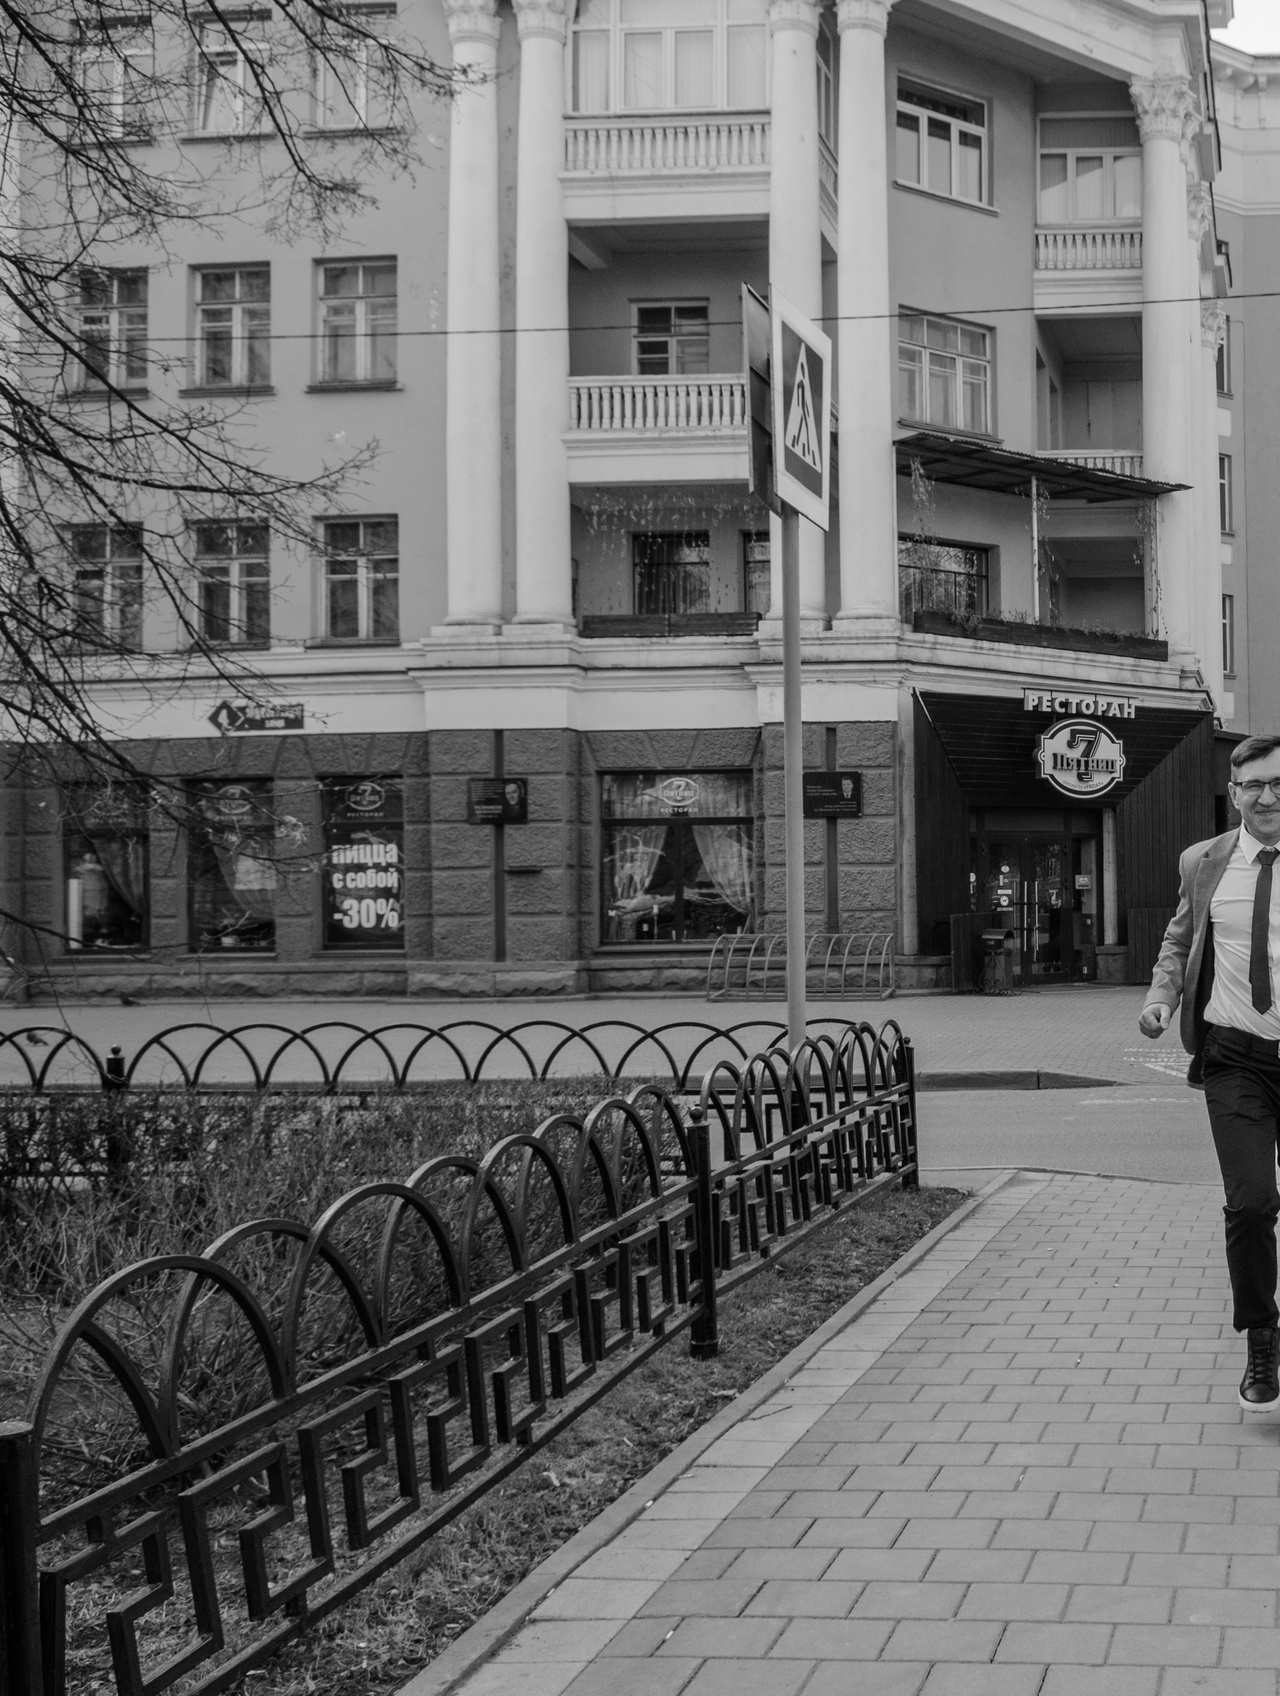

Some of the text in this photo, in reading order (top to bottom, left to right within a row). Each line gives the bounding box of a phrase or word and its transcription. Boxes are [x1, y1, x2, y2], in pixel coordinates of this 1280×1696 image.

[1025, 695, 1135, 718] РЕСТОРАН
[1067, 728, 1102, 782] 7
[332, 844, 398, 866] пицца
[332, 868, 398, 893] с собой
[333, 898, 399, 928] -30%
